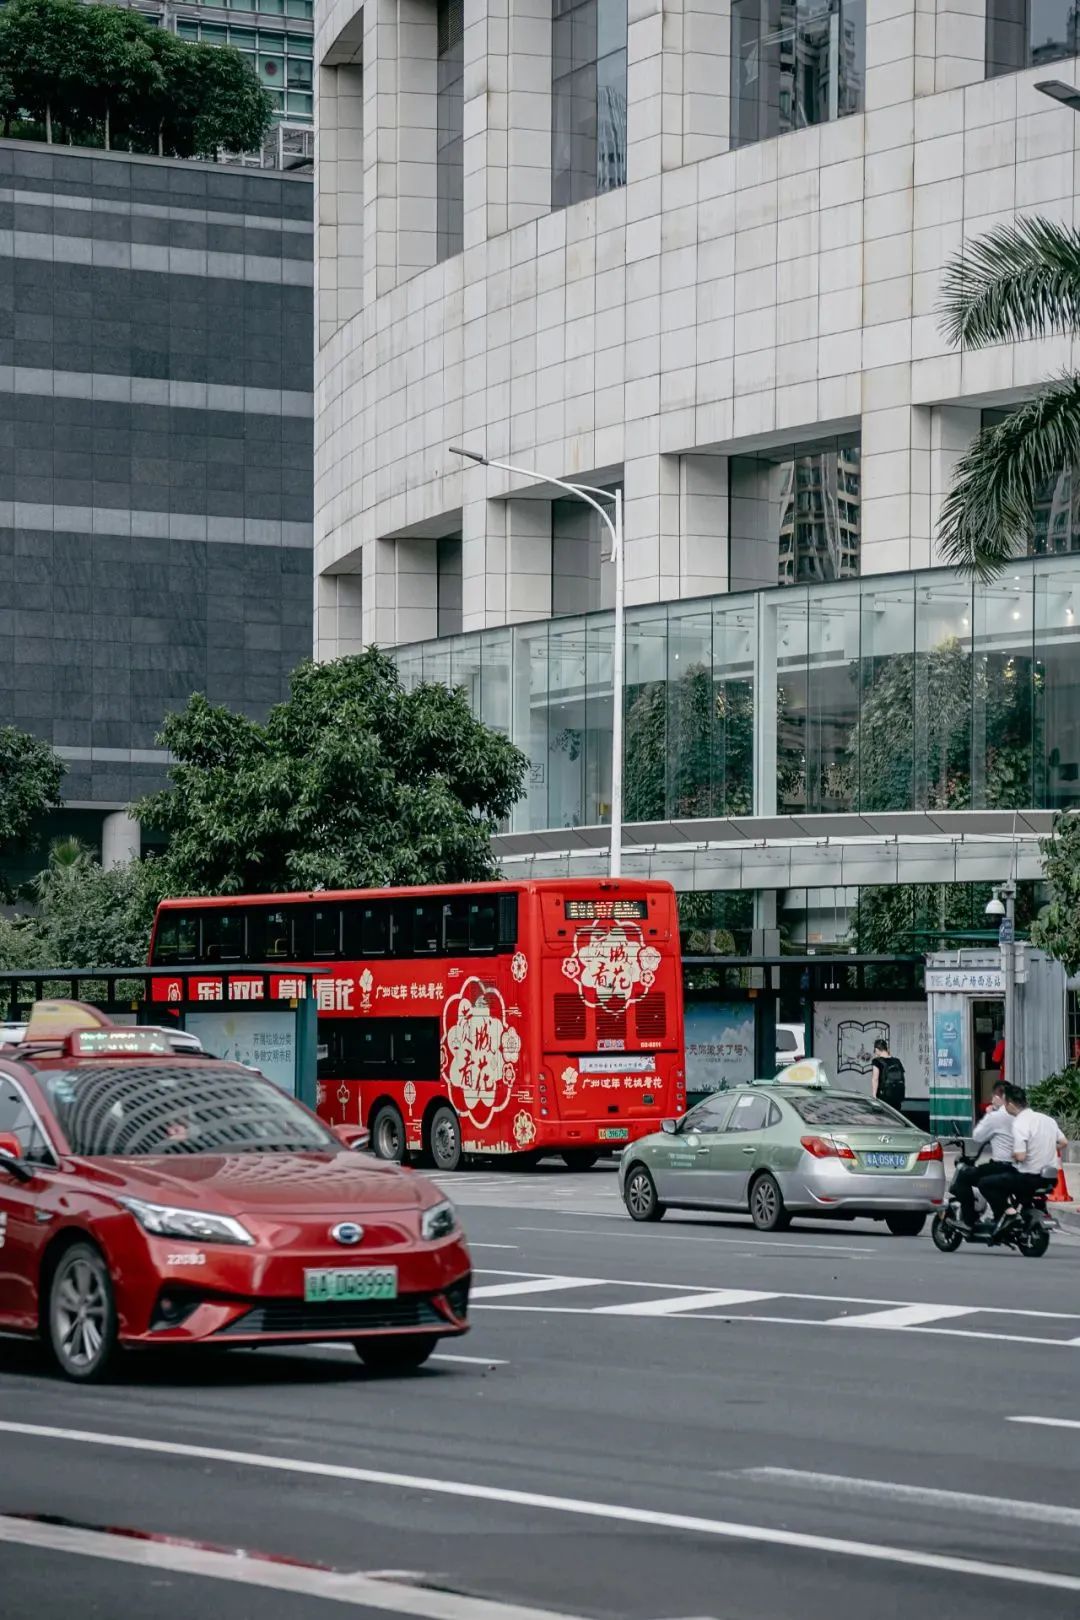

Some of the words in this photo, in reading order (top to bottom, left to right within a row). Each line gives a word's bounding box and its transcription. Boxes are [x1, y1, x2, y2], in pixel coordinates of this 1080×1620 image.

[376, 985, 407, 1000] 广州过年
[582, 1078, 620, 1089] 广州过年
[623, 1076, 663, 1089] 花城看花
